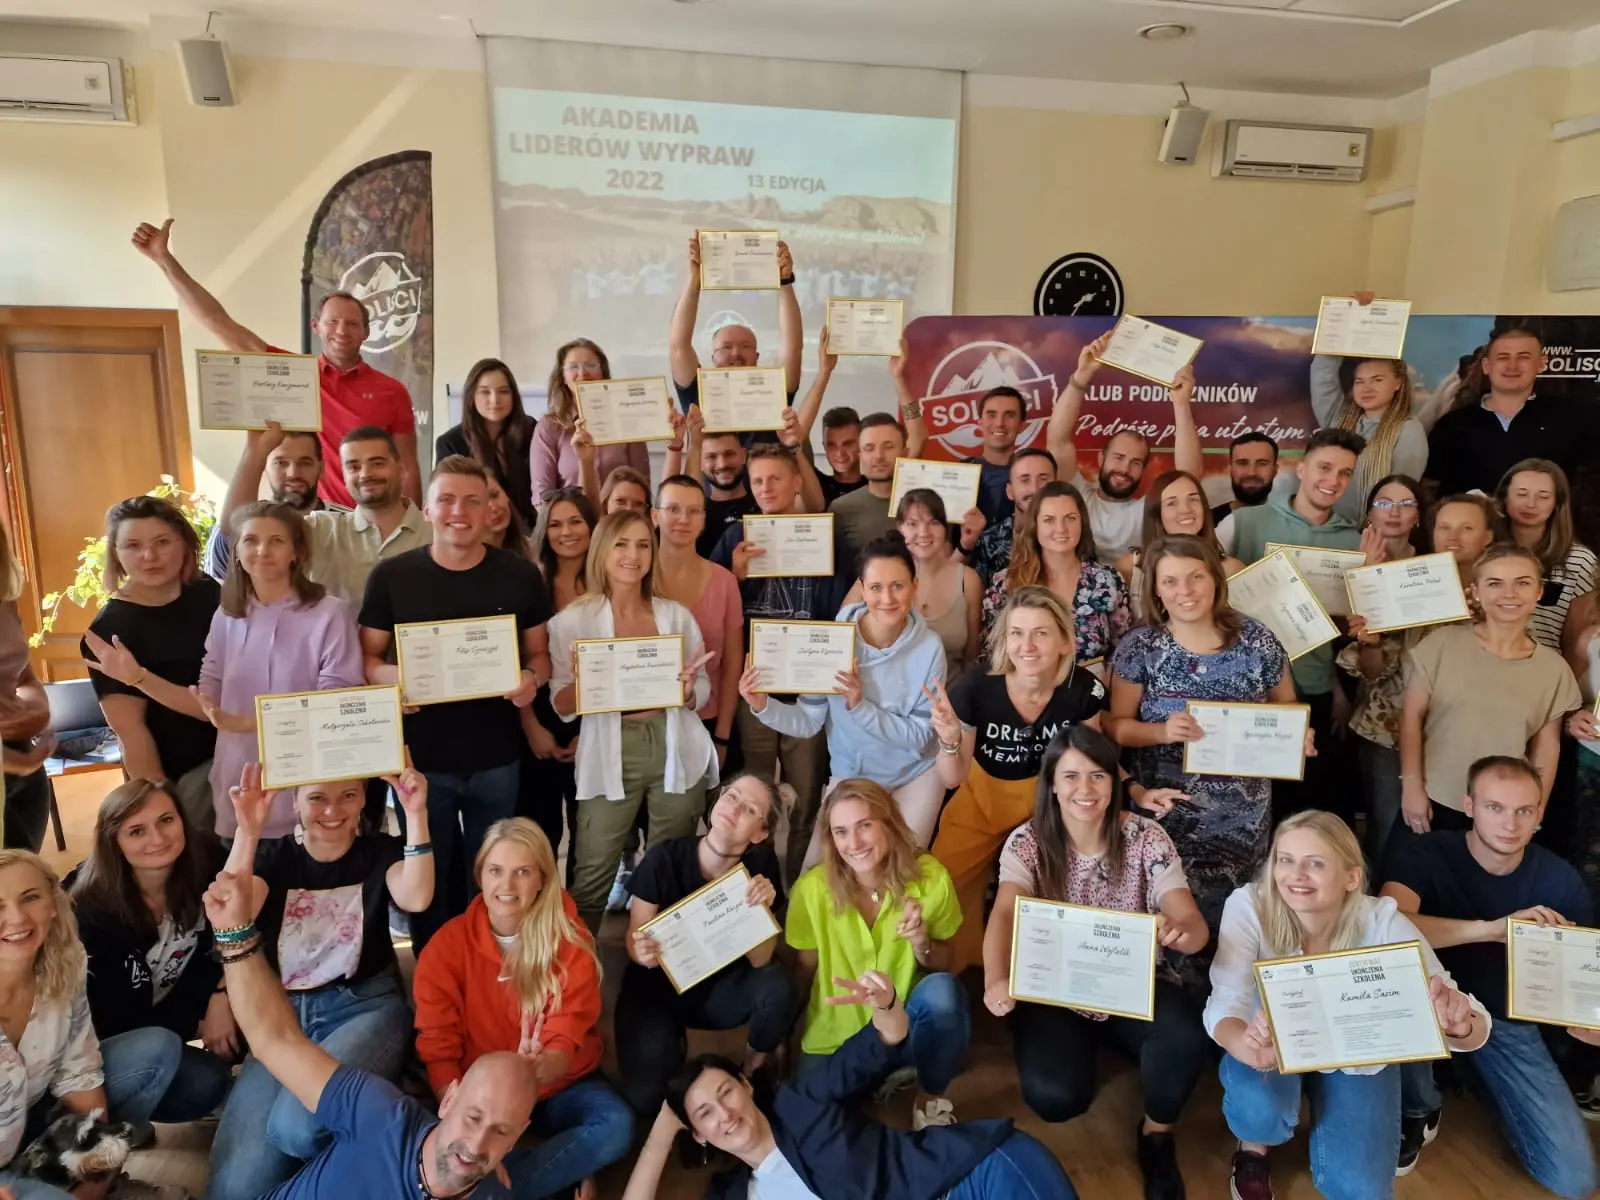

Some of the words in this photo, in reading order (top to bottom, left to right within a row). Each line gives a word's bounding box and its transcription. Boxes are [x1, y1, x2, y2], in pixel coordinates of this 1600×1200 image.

[561, 105, 699, 134] AKADEMIA
[509, 131, 630, 160] LIDERÓW
[637, 141, 755, 167] WYPRAW
[606, 169, 664, 191] 2022
[747, 173, 764, 188] 13
[769, 176, 826, 194] EDYCJA
[1352, 972, 1386, 984] SZKOLENIA
[1340, 990, 1371, 1003] Kamila
